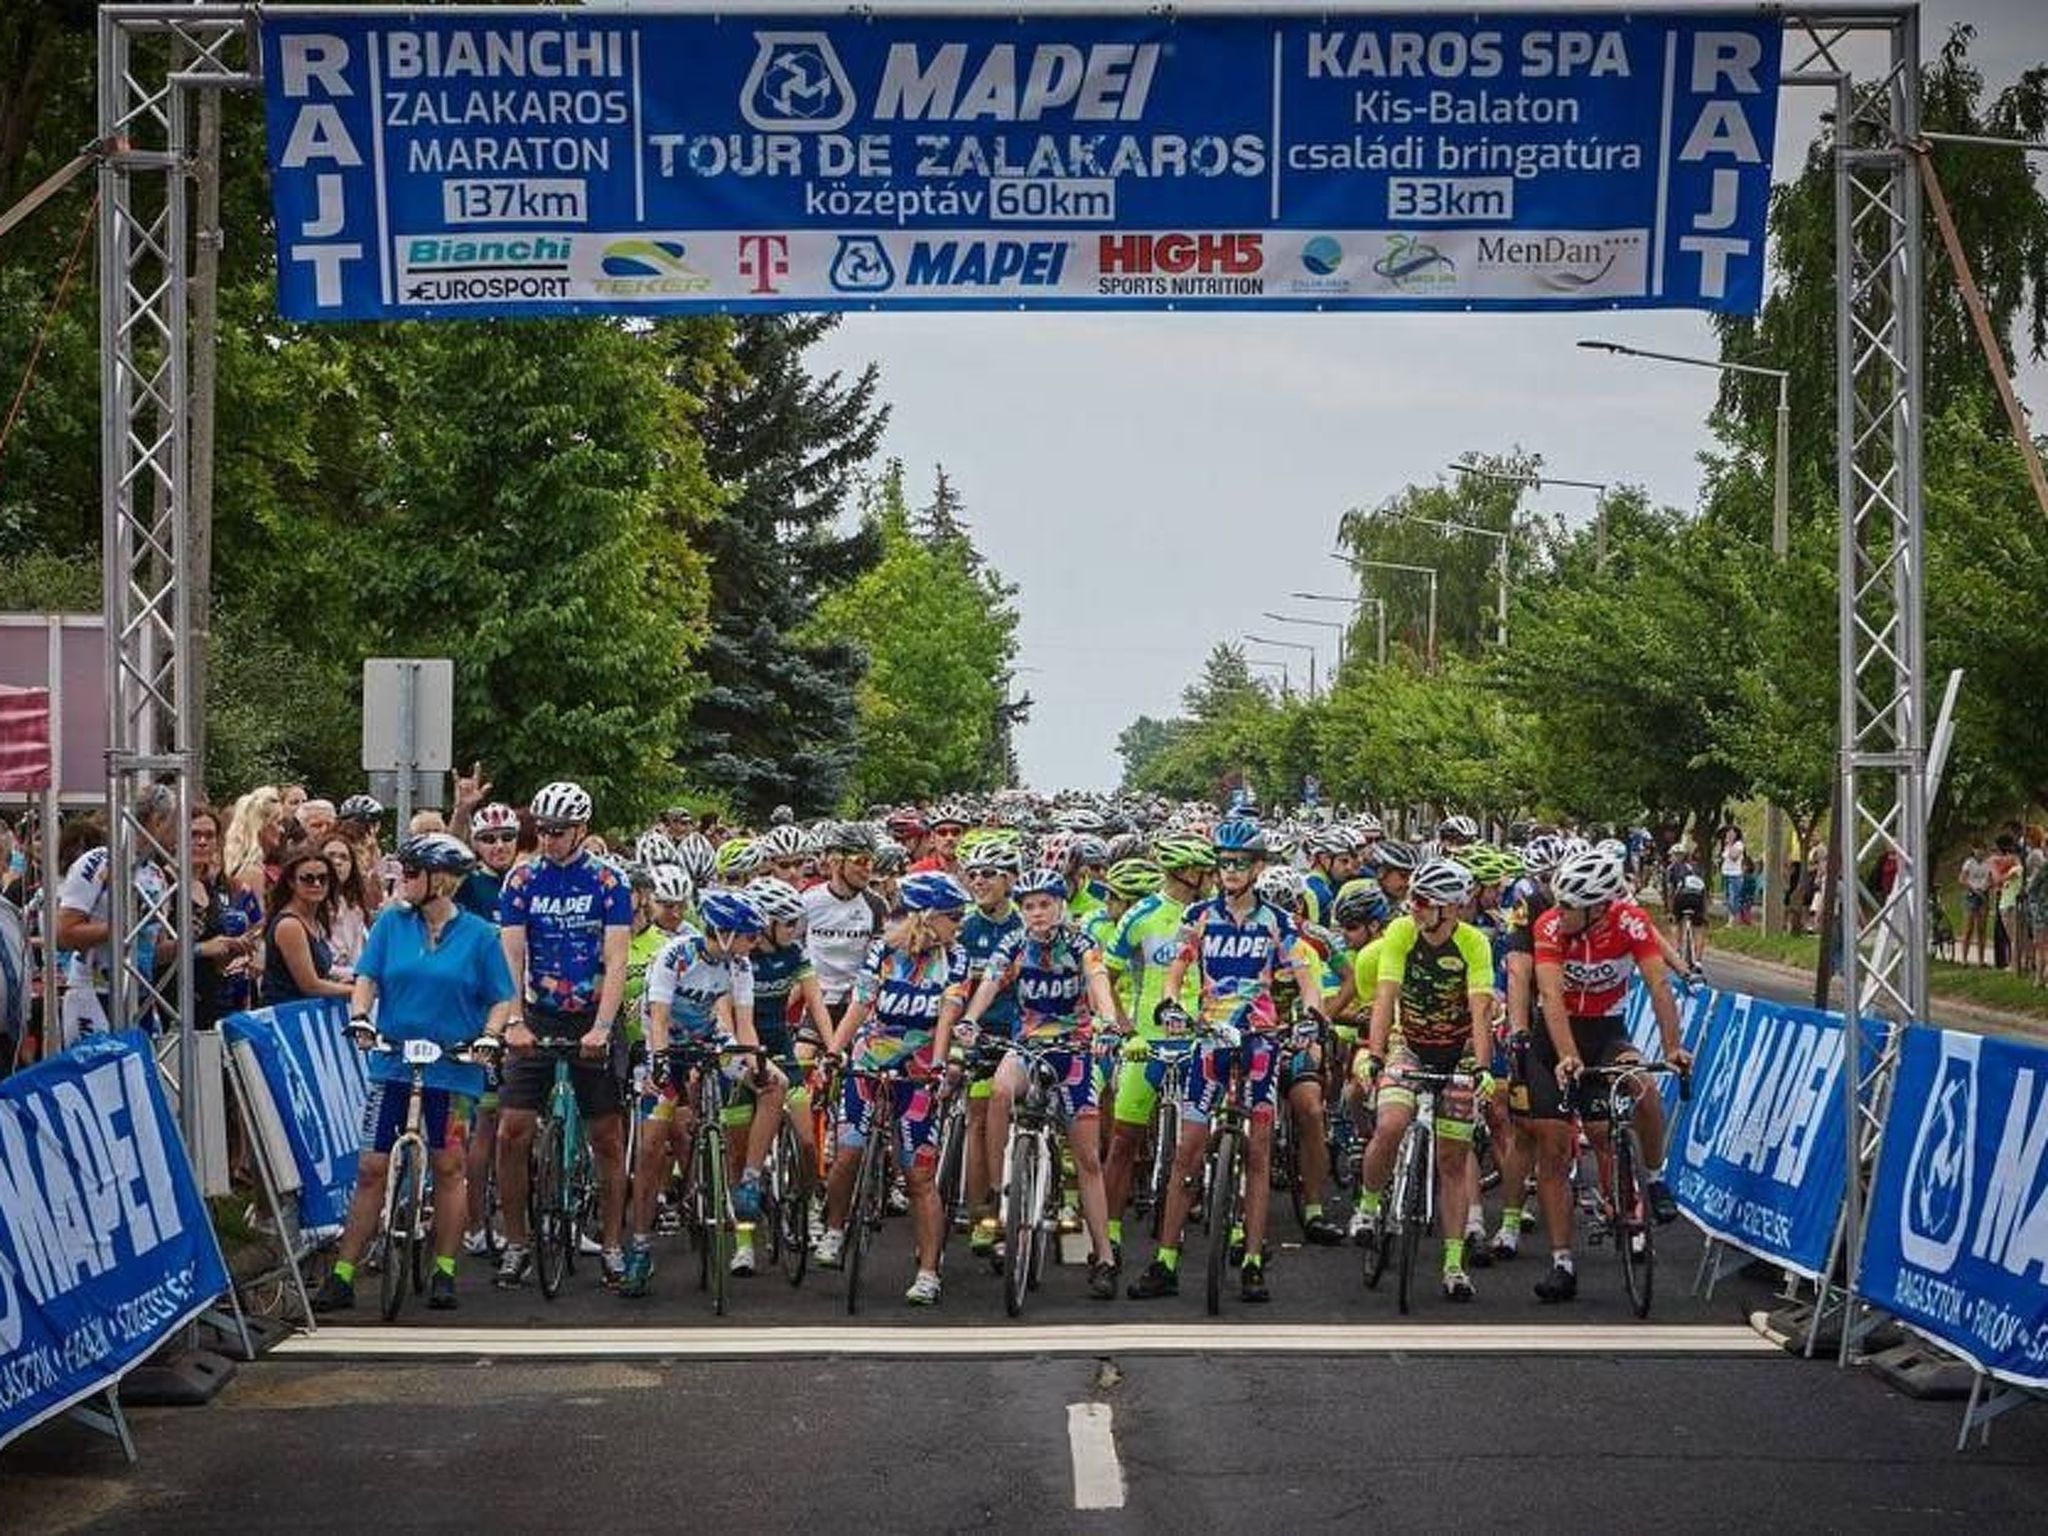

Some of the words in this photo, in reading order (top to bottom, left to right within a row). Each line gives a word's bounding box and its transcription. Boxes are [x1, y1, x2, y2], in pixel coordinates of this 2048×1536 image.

[388, 30, 623, 78] BIANCHI
[1307, 30, 1502, 78] KAROS
[1521, 30, 1631, 77] SPA
[872, 42, 1161, 121] MAPEI
[386, 90, 627, 126] ZALAKAROS
[1354, 90, 1578, 124] Kis-Balaton
[280, 33, 363, 308] RAJT
[409, 136, 610, 173] MARATON
[649, 134, 801, 178] TOUR
[818, 134, 891, 177] DE
[915, 134, 1267, 178] ZALAKAROS
[1288, 134, 1424, 170] családi
[1437, 134, 1641, 177] bringatúra
[1678, 31, 1762, 299] RAJT
[454, 182, 578, 218] 137km
[805, 182, 983, 225] középtáv
[996, 182, 1110, 217] 60km
[1393, 182, 1505, 217] 33km
[407, 236, 571, 264] Bianchi
[904, 241, 1069, 286] MAPEI
[1099, 233, 1264, 273] HIGH5
[1477, 236, 1602, 265] MenDan
[420, 277, 570, 300] EUROSPORT
[1099, 277, 1167, 296] SPORTS
[1171, 277, 1264, 296] NUTRITION
[529, 894, 593, 915] MAPEI
[877, 990, 940, 1018] MAPE
[1716, 1014, 1847, 1188] MAPEI
[0, 1052, 183, 1305] MAPEI
